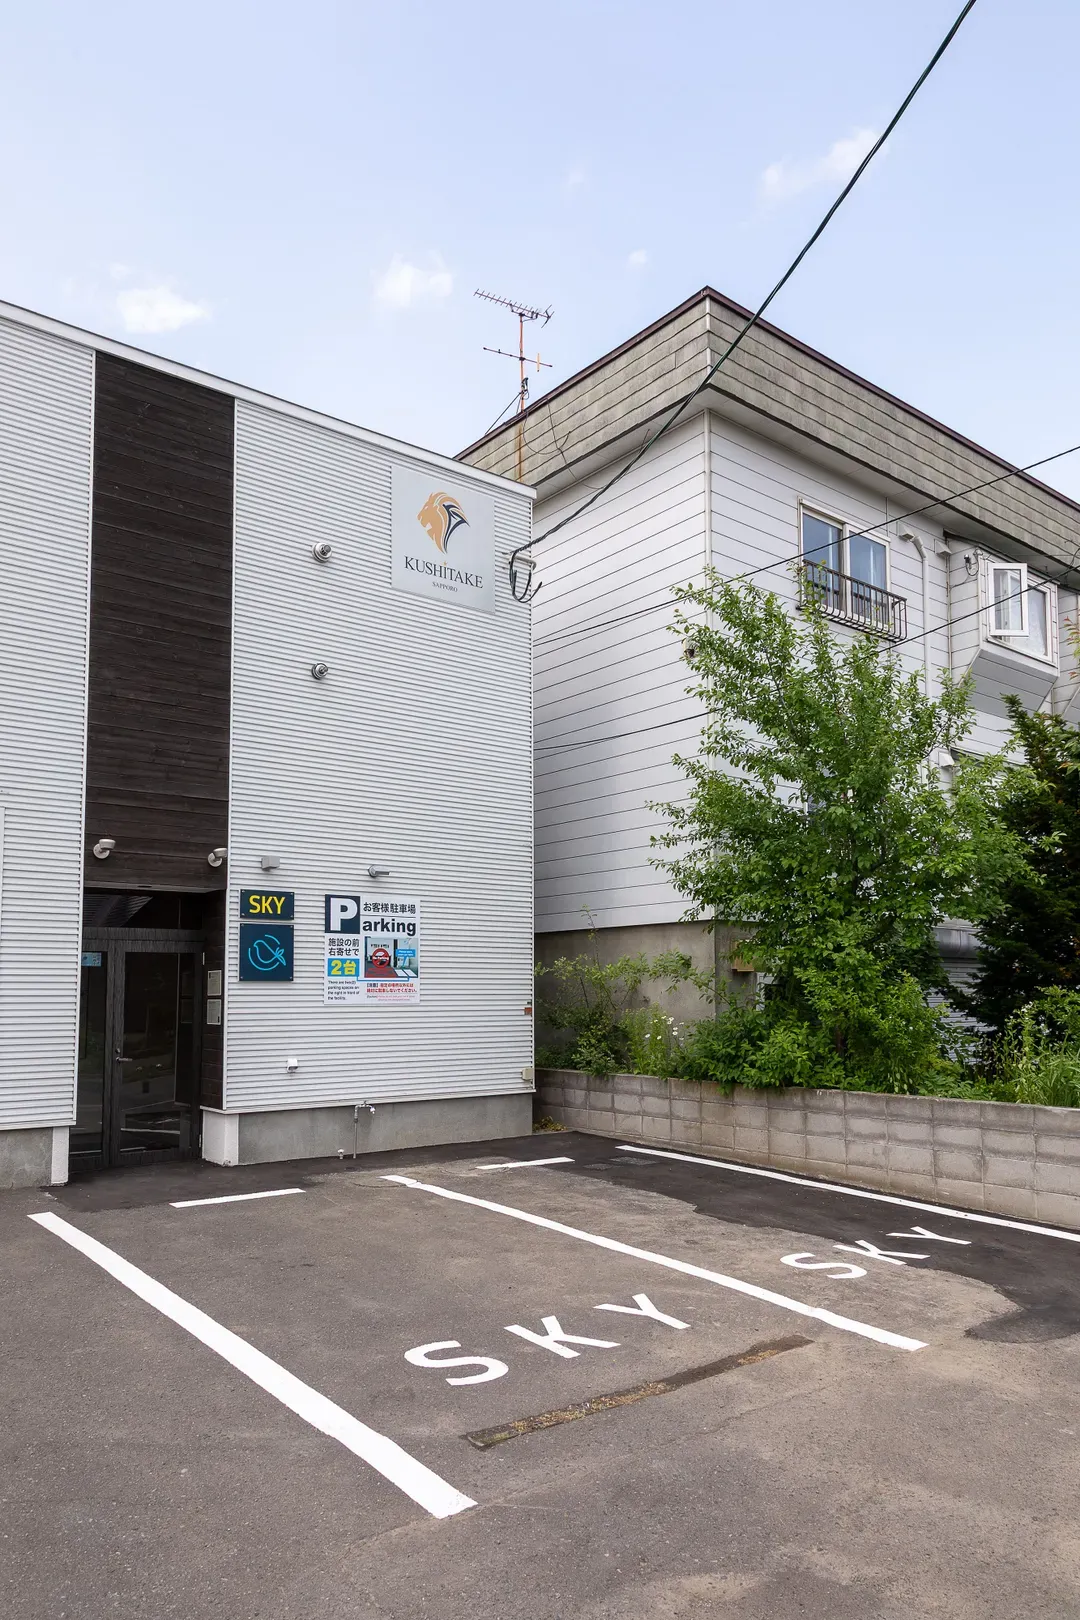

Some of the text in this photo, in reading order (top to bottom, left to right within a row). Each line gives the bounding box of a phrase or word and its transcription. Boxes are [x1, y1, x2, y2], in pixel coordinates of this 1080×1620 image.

[404, 556, 483, 589] KUSHITAKE
[432, 581, 458, 593] SAPPORO
[249, 894, 286, 914] SKY
[363, 902, 416, 914] お客様駐車場
[328, 938, 360, 948] 施設の前
[328, 947, 360, 956] 右寄せで
[331, 960, 357, 975] 2台
[779, 1225, 972, 1280] SKY
[403, 1293, 691, 1386] SKY
